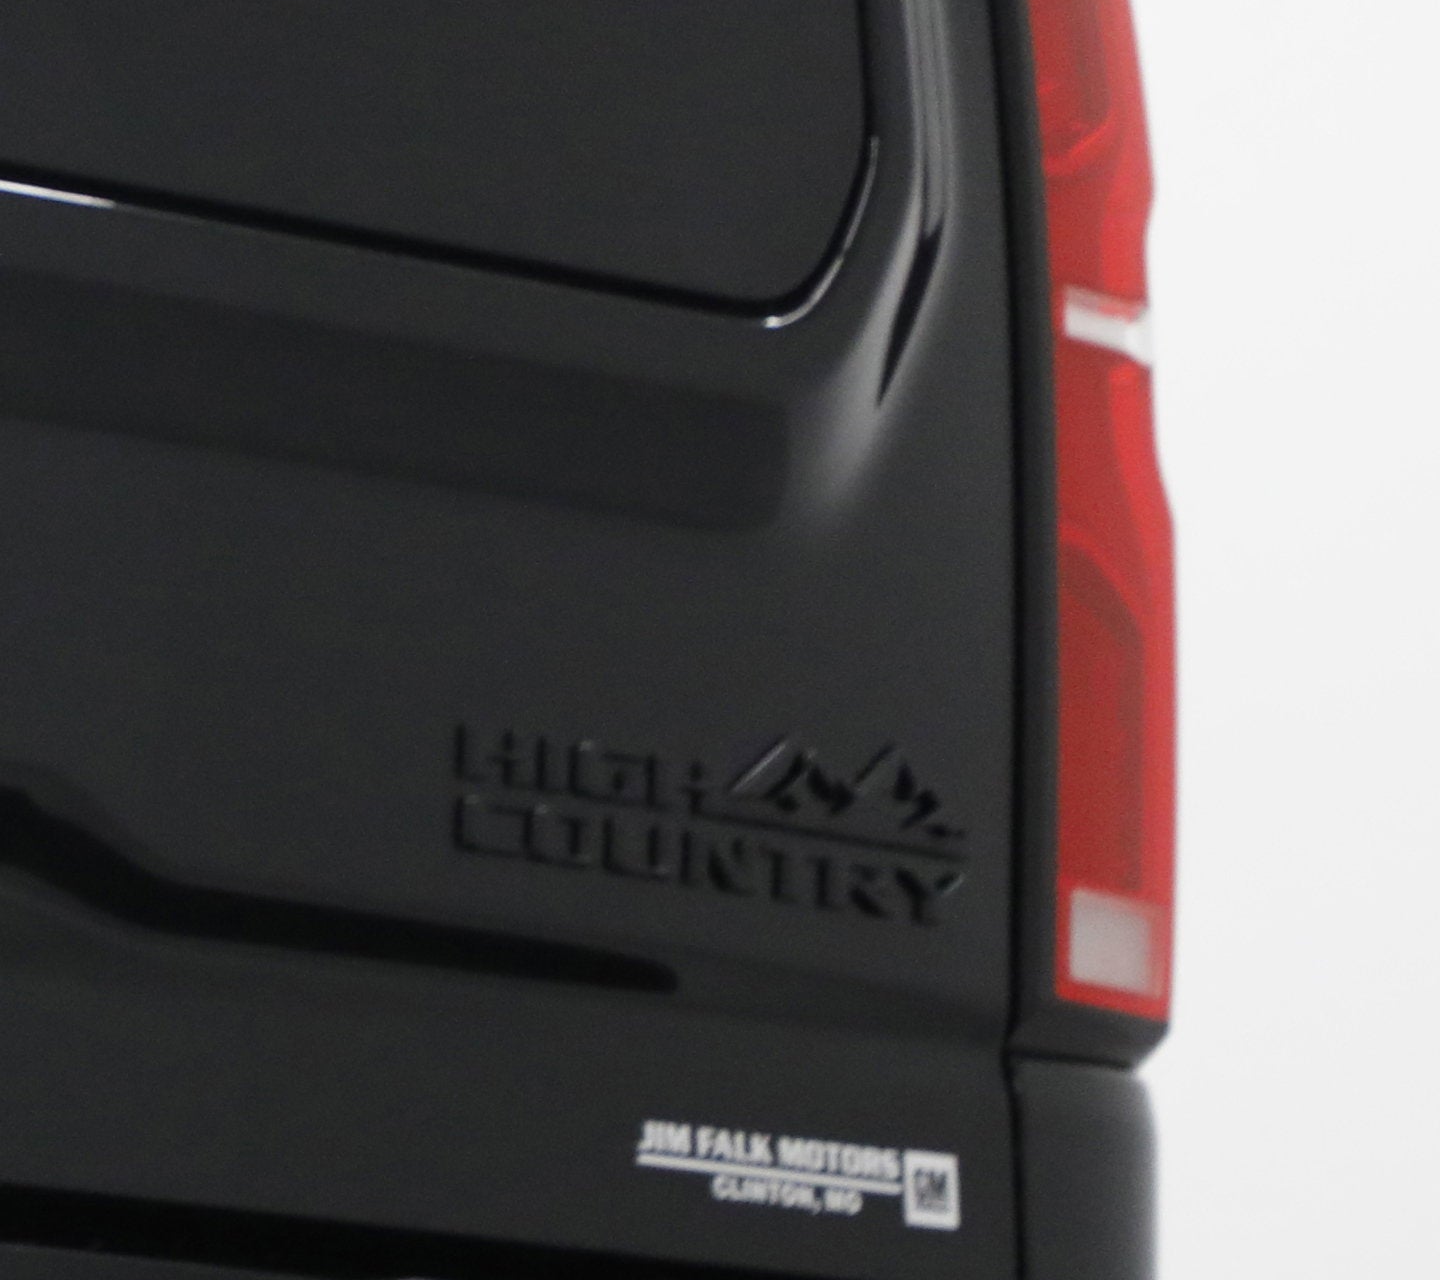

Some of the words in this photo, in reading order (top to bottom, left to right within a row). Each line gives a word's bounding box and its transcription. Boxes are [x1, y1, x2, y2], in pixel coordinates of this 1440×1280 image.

[455, 723, 707, 817] HIGH
[455, 794, 964, 924] COUNTRY
[637, 1120, 692, 1154] JIM
[696, 1125, 772, 1164] FALK
[777, 1136, 901, 1179] MOTORS
[711, 1176, 823, 1216] CLINTON,
[824, 1190, 863, 1216] MO
